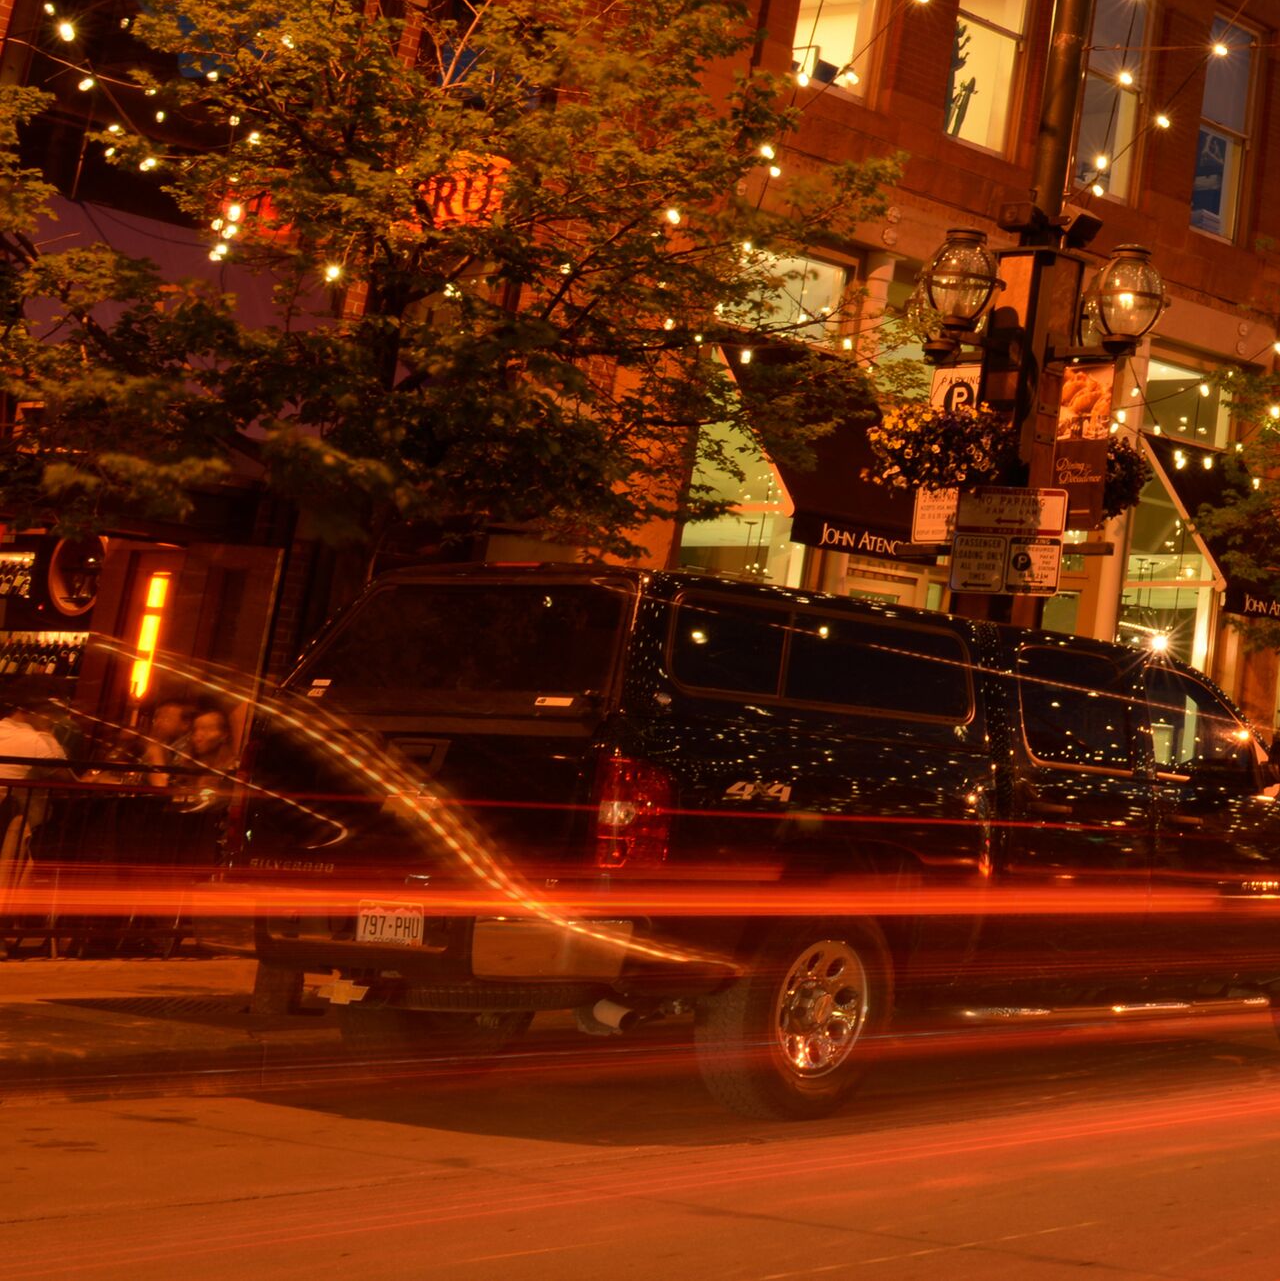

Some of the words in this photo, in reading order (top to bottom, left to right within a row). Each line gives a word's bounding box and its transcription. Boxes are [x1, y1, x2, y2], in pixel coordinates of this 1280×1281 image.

[1000, 496, 1046, 508] PARKING
[819, 523, 856, 548] JOHN
[858, 531, 910, 556] ATENC
[1020, 536, 1052, 545] PARKING
[1244, 593, 1268, 614] JOHN
[250, 859, 335, 872] SILVERADO
